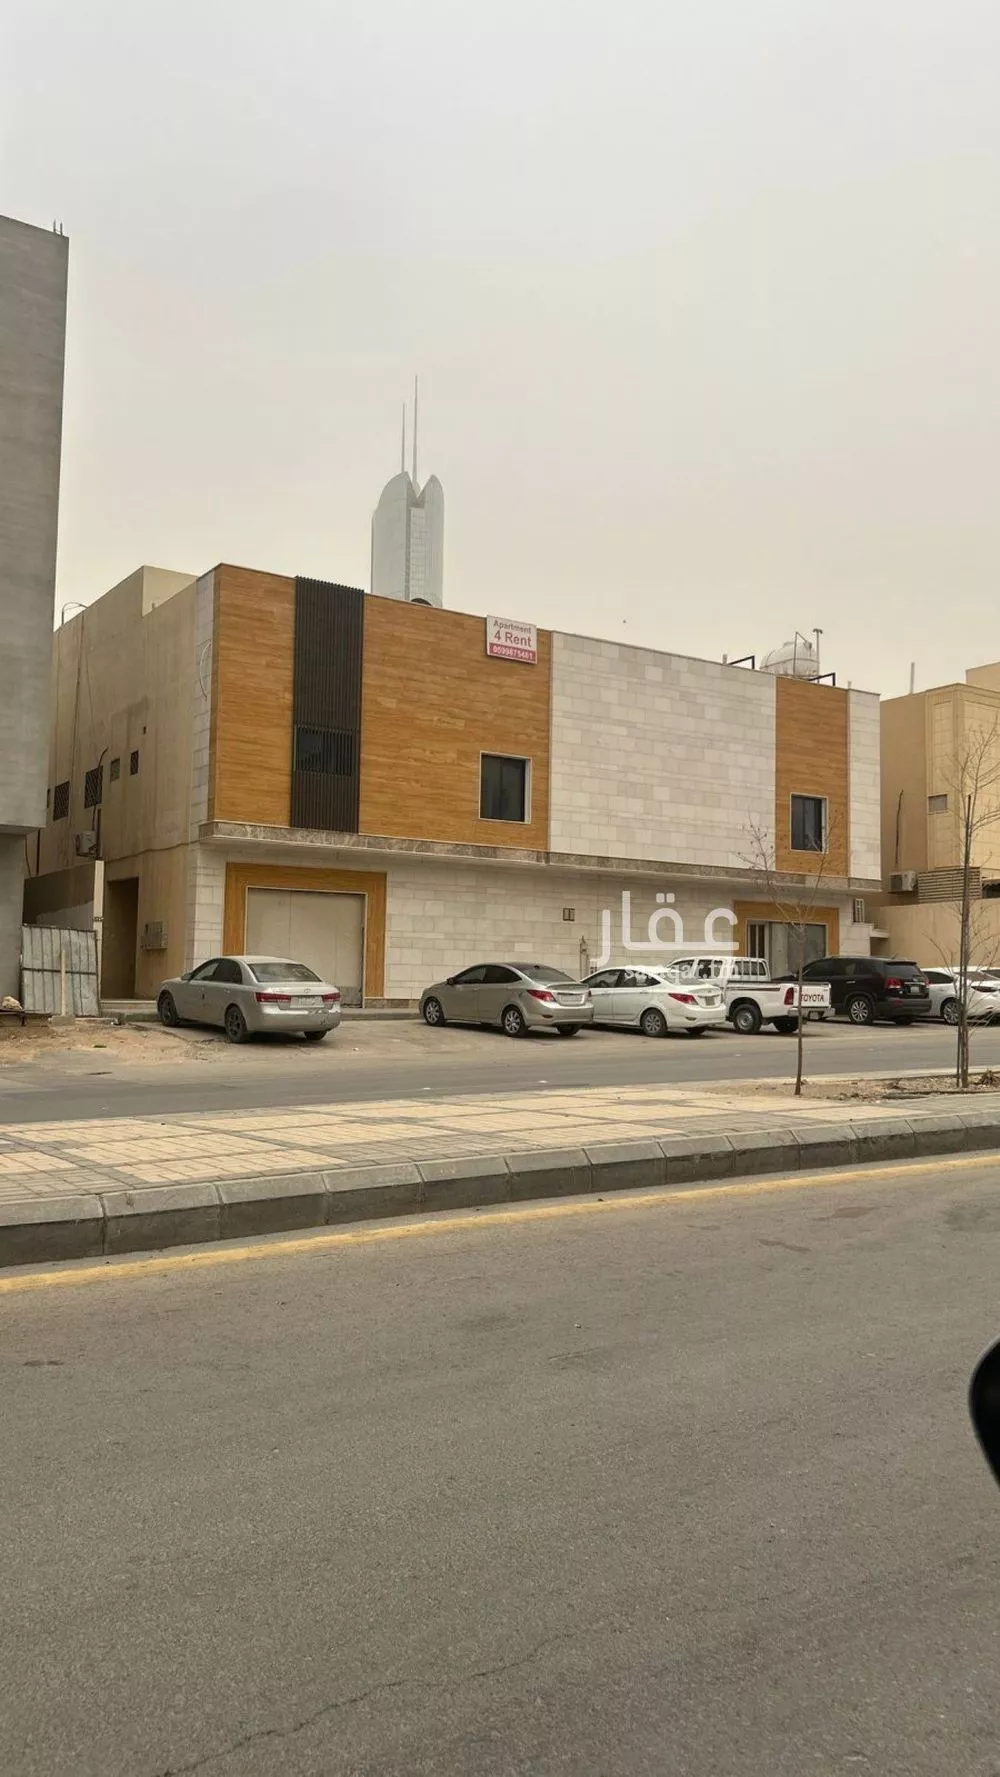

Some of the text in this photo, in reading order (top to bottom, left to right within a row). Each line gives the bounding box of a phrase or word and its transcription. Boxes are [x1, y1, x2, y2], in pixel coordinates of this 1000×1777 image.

[493, 620, 531, 634] Apartment
[494, 630, 532, 647] 4 Rent
[800, 993, 824, 1002] TOYOTA
